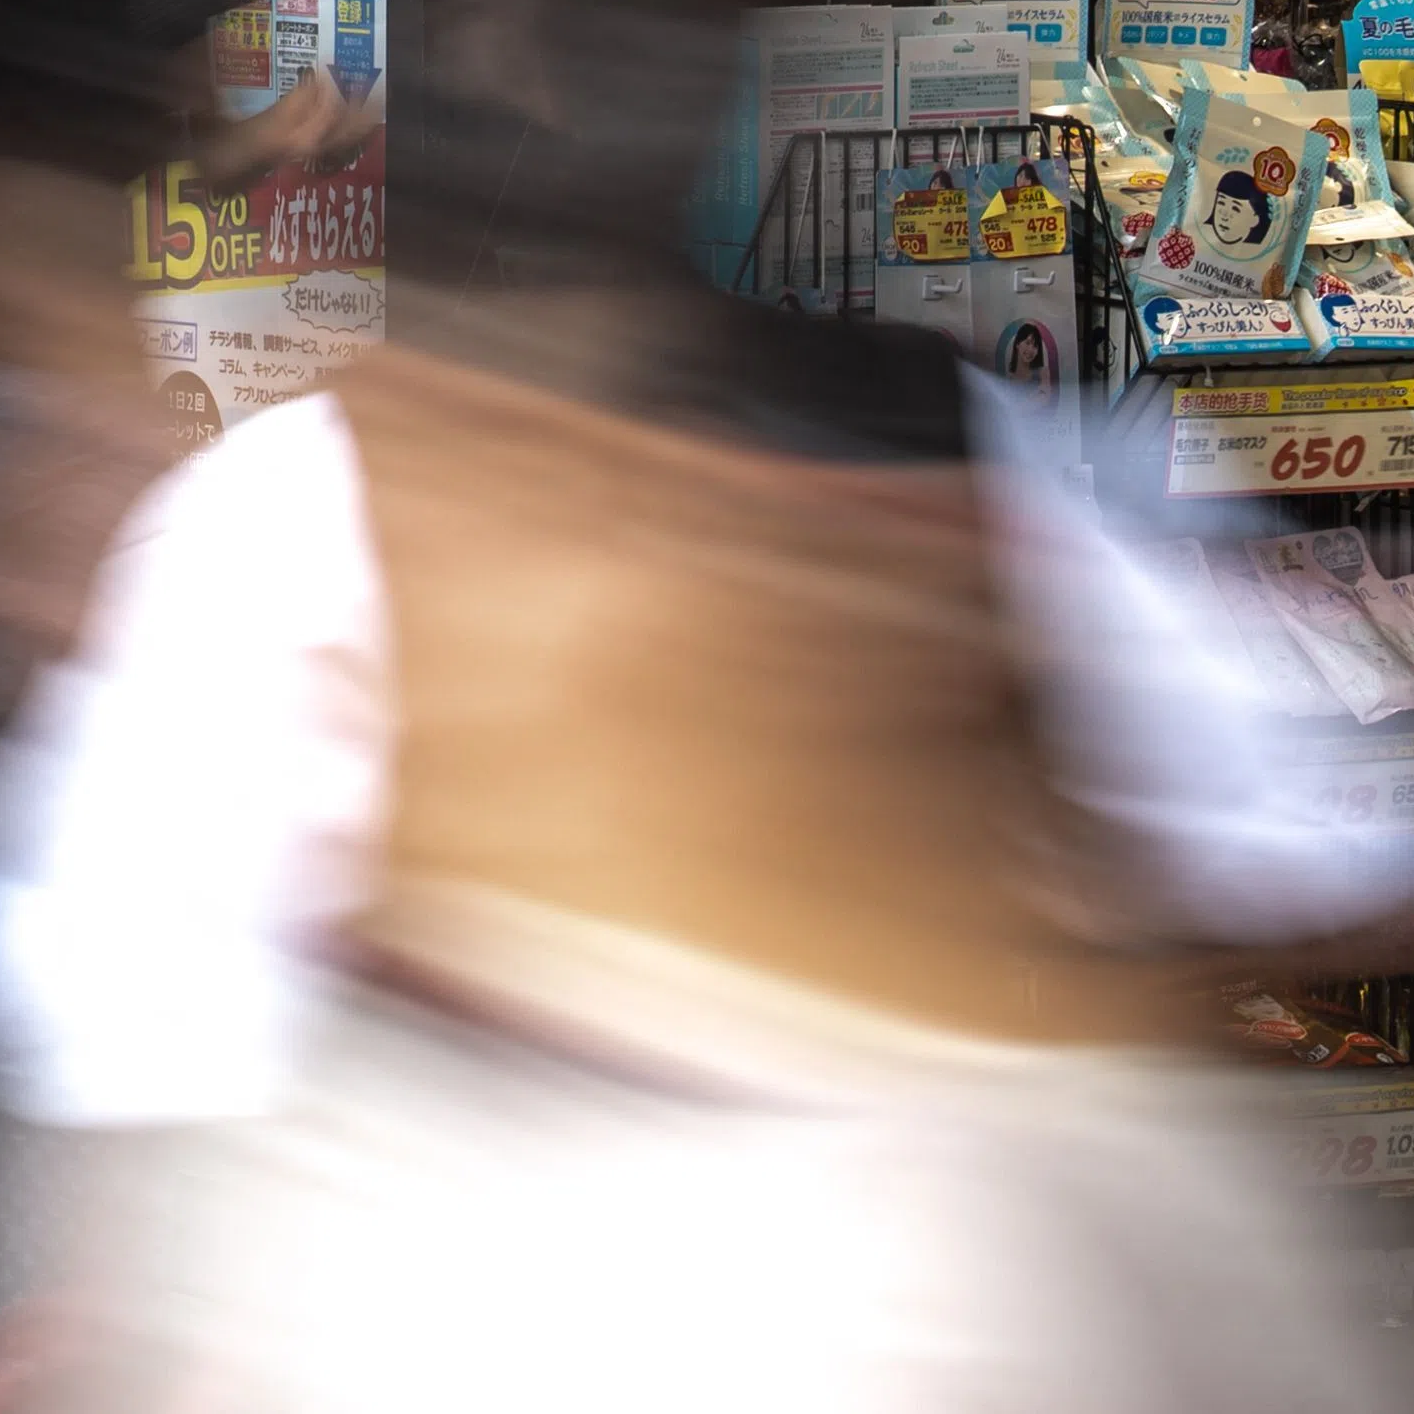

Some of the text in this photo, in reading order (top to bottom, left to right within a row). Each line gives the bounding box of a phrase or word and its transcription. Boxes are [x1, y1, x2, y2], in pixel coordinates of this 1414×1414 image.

[1260, 158, 1284, 180] 10
[1026, 216, 1058, 233] 478
[210, 233, 261, 272] OFF
[988, 238, 1006, 251] 20
[1192, 260, 1257, 291] 100%国産米
[1186, 302, 1270, 318] ふっくらしっとり
[1178, 390, 1270, 414] 本店的抢手货
[1270, 435, 1366, 482] 650
